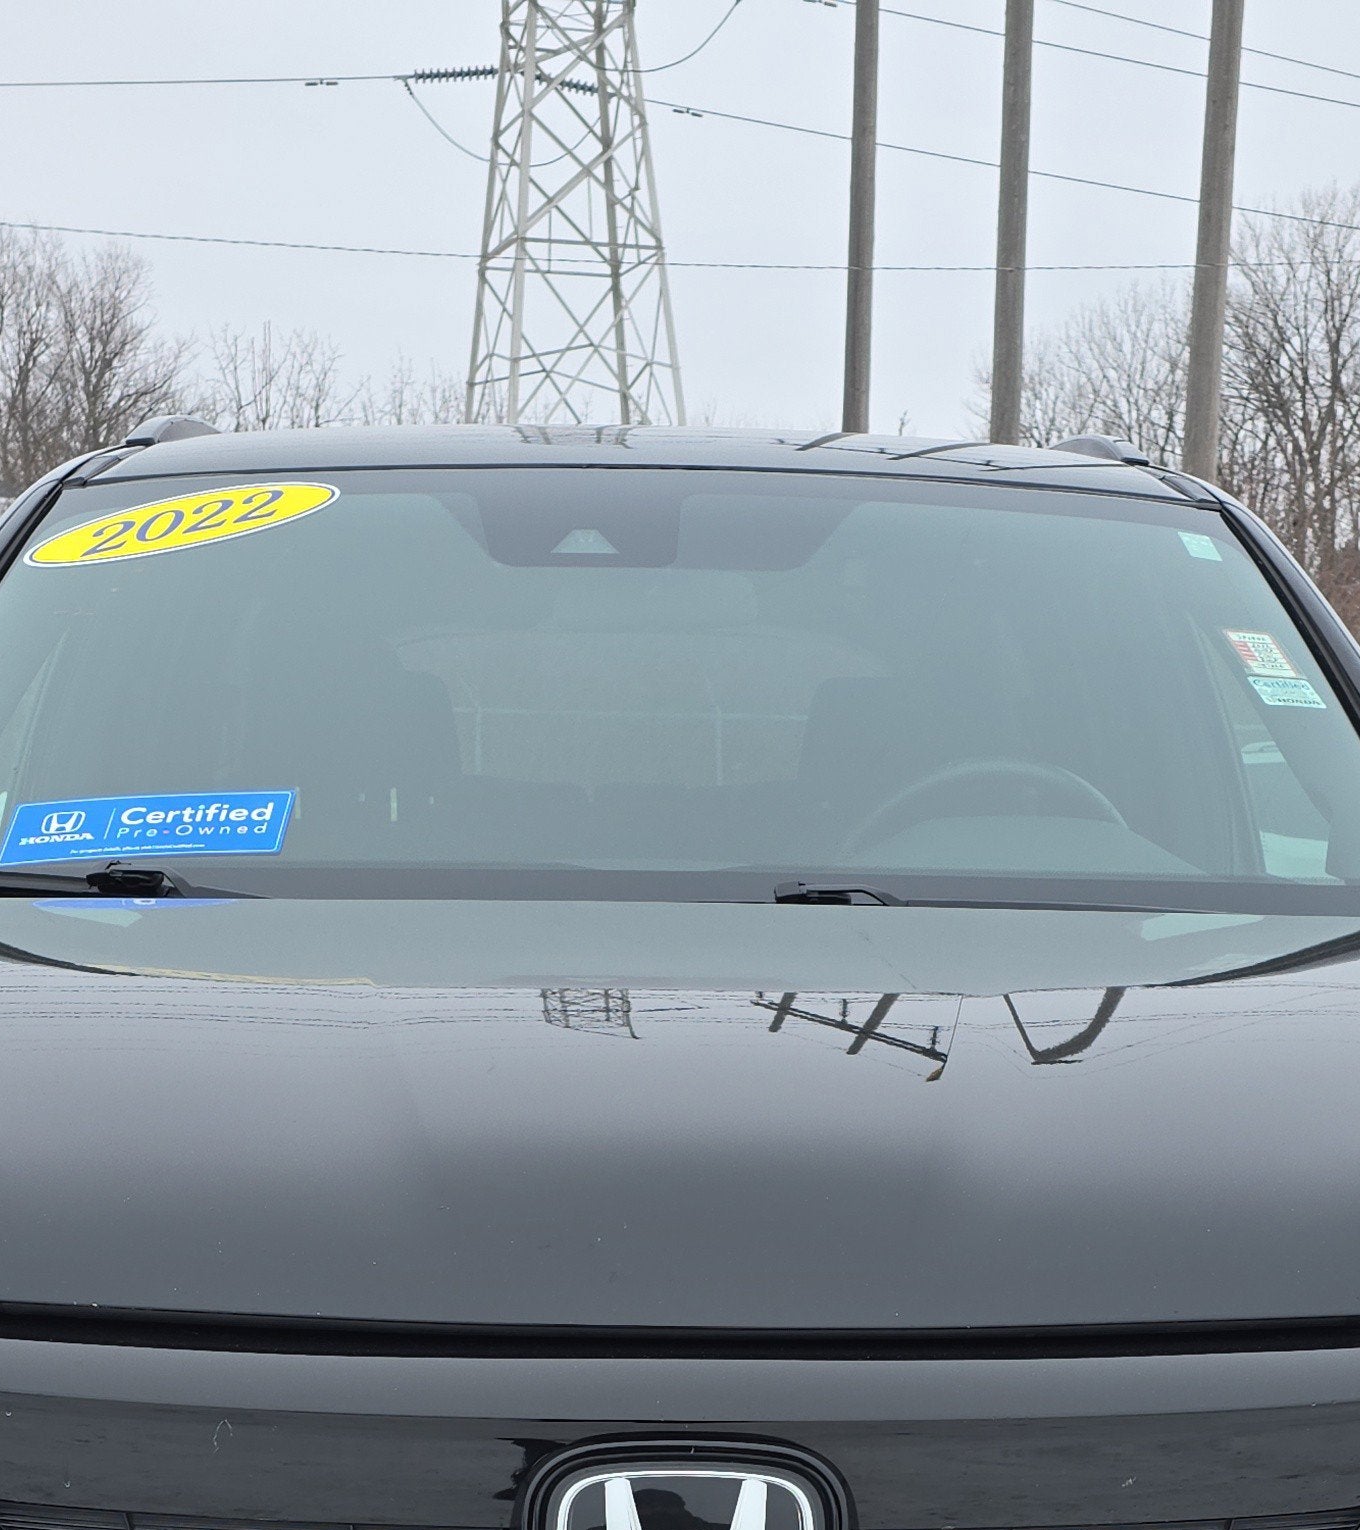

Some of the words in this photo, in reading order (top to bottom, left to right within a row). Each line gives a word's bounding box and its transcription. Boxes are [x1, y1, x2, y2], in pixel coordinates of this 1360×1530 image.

[81, 489, 284, 557] 2022
[121, 802, 274, 825] Certified
[19, 833, 94, 845] HONDA
[117, 822, 267, 838] Pre-Owned
